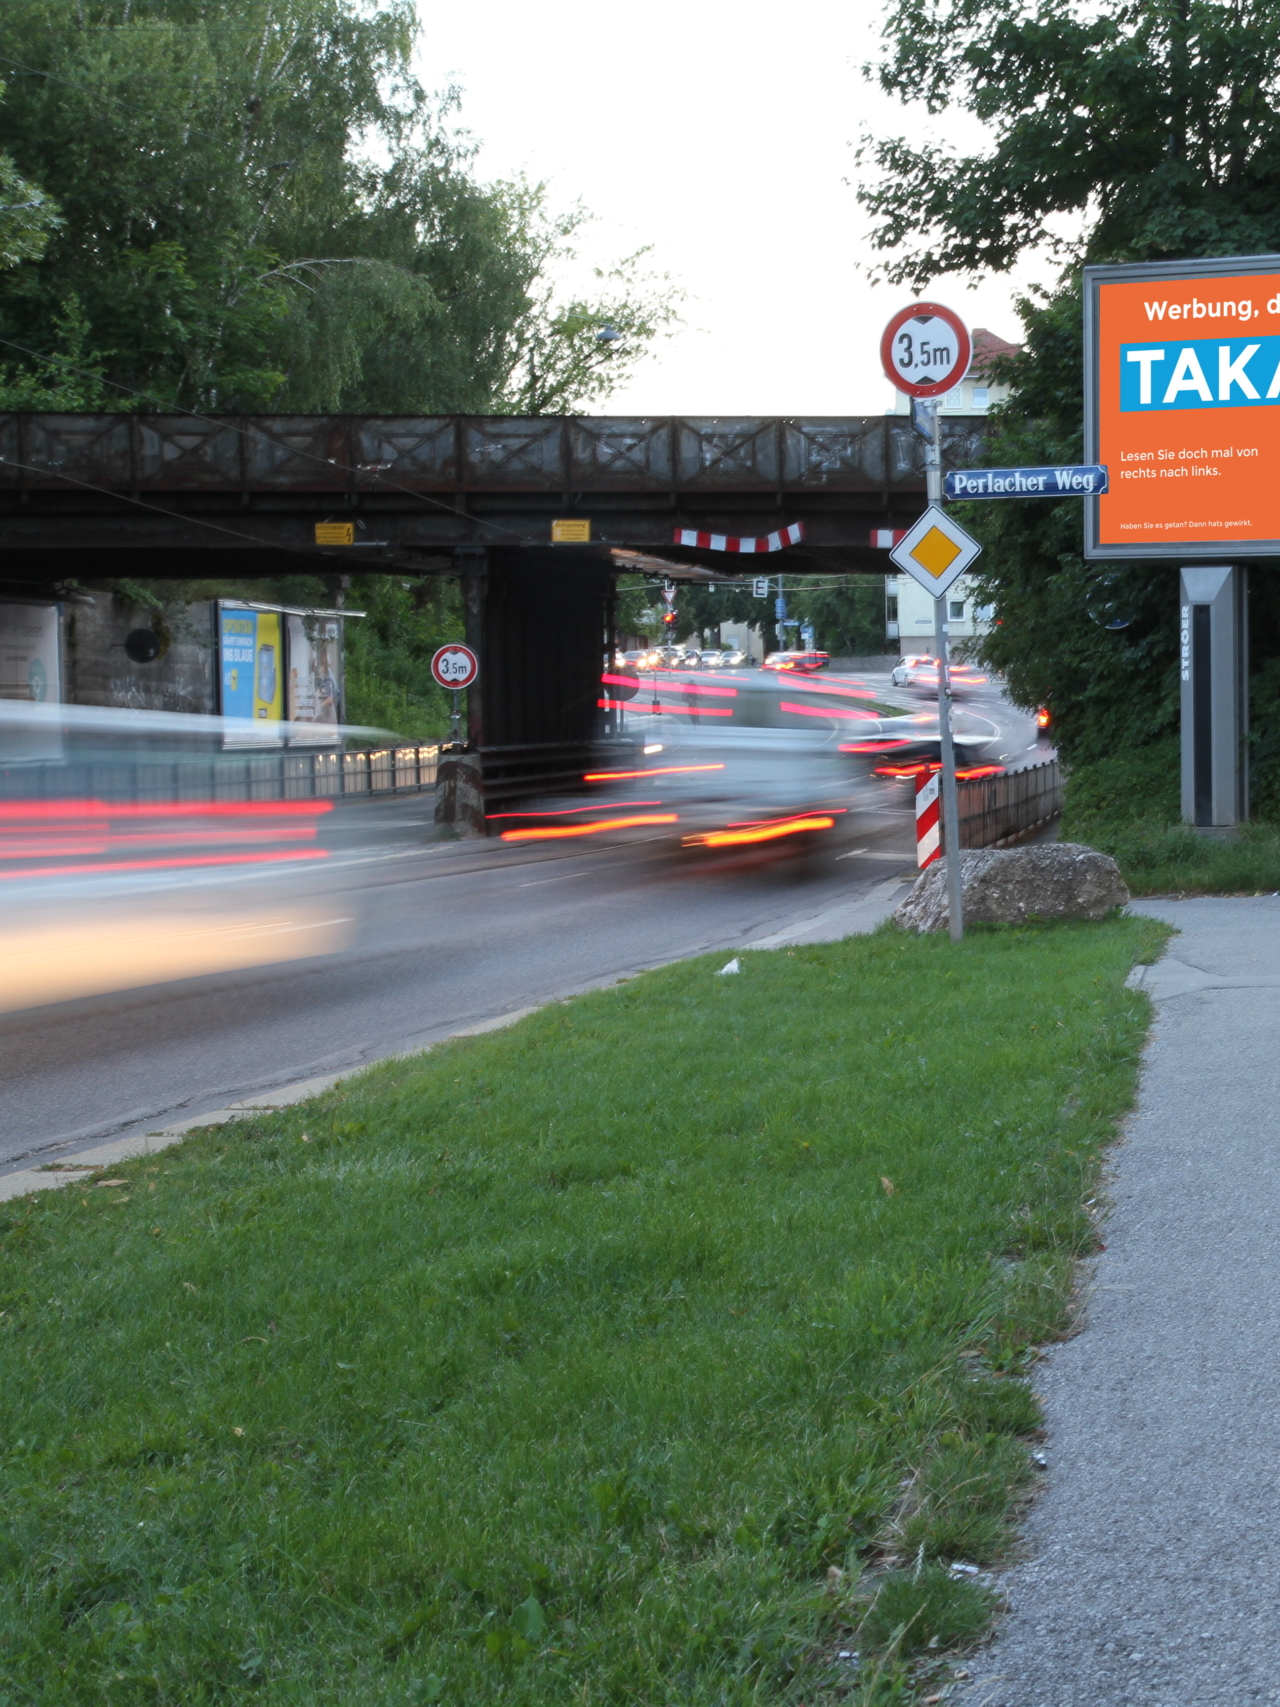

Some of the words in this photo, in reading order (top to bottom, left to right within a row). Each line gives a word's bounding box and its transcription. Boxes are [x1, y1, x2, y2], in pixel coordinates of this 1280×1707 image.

[1143, 297, 1260, 321] Werbung,
[898, 333, 950, 369] 3,5m
[1120, 451, 1155, 462] Lesen
[1157, 449, 1175, 460] Sie
[1178, 447, 1208, 459] doch
[1211, 446, 1233, 458] mal
[1236, 447, 1259, 457] von
[1120, 467, 1157, 479] rechts
[1160, 466, 1188, 477] nach
[1191, 465, 1222, 477] links.
[953, 471, 1047, 495] Perlacher
[1054, 470, 1095, 493] Weg
[1120, 522, 1142, 530] Haben
[1143, 521, 1154, 529] Sie
[1164, 521, 1187, 530] getan?
[1224, 519, 1253, 528] gewirkt.
[755, 580, 765, 596] E
[222, 648, 234, 662] INS
[234, 648, 253, 662] BLAUE
[441, 658, 468, 675] 3,5m
